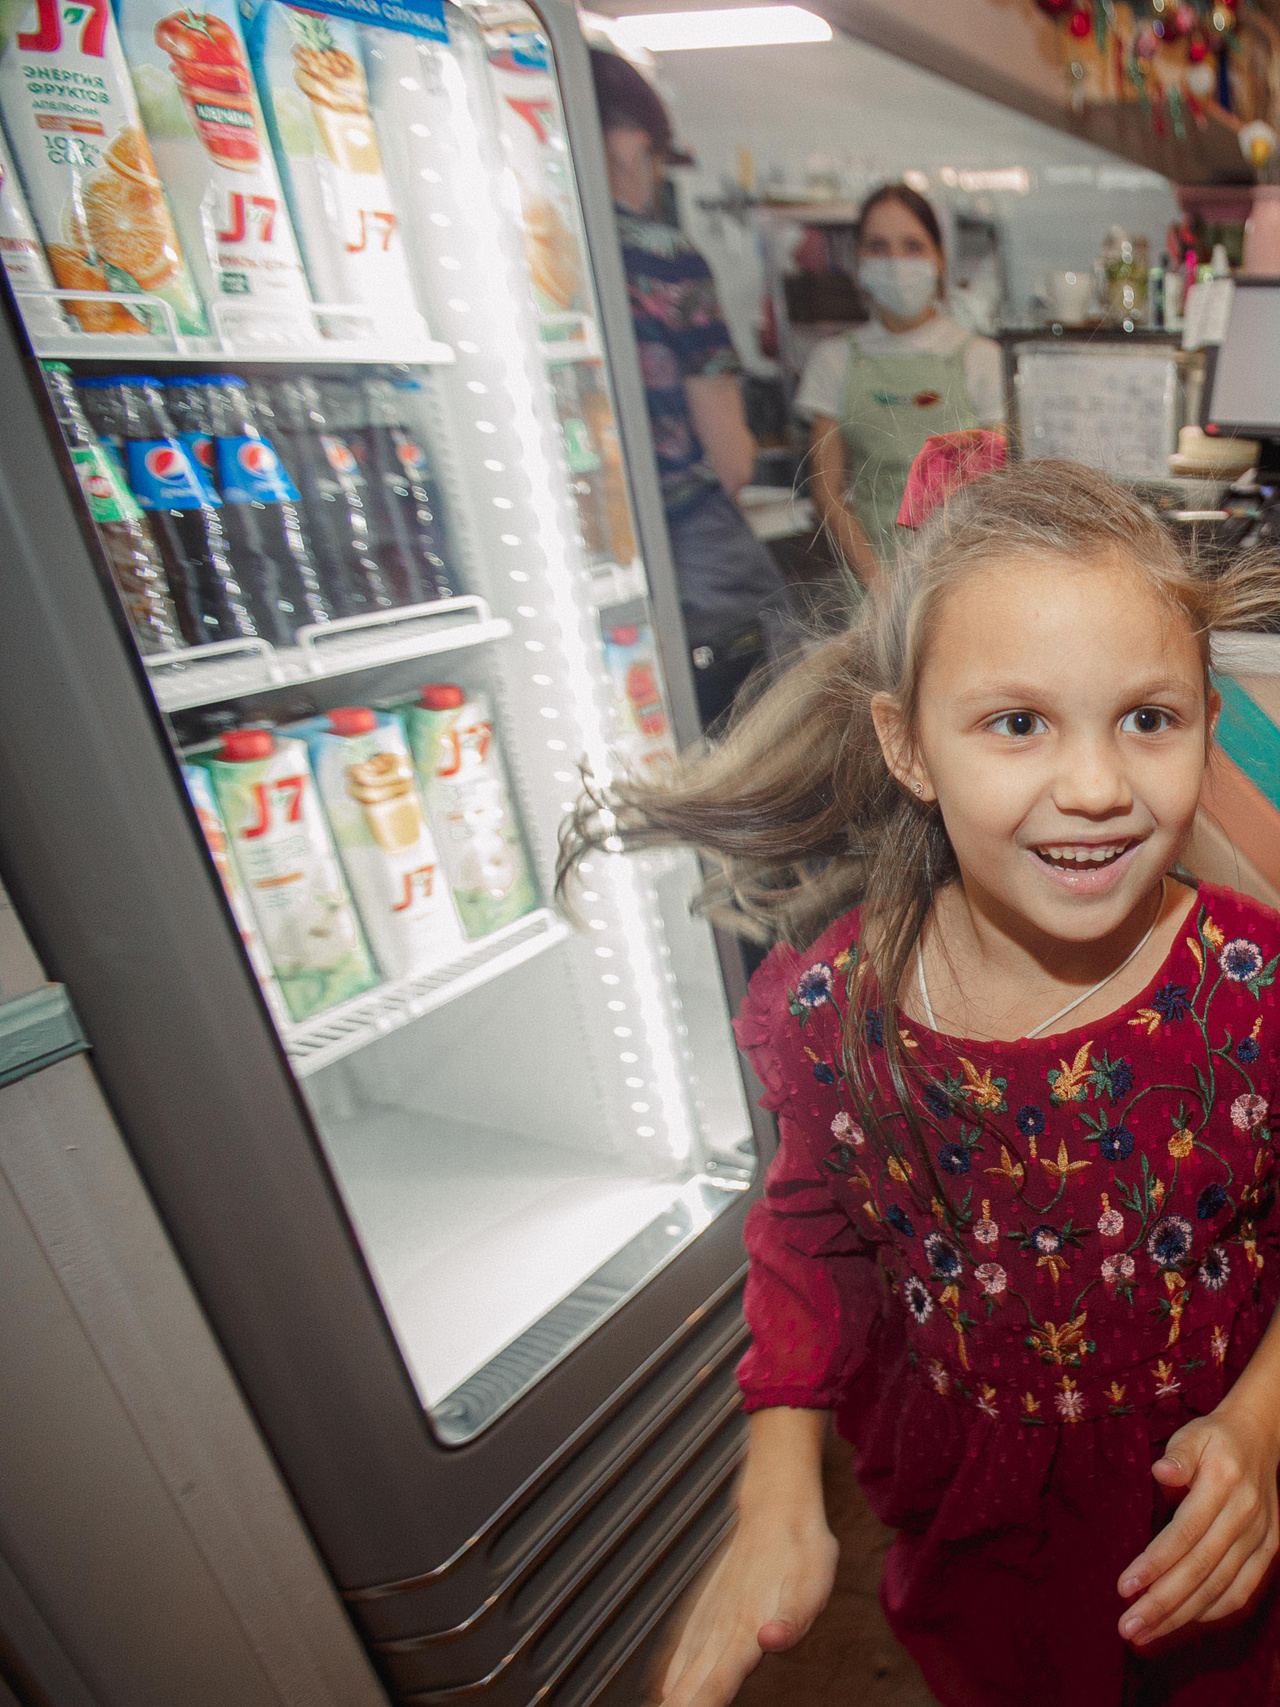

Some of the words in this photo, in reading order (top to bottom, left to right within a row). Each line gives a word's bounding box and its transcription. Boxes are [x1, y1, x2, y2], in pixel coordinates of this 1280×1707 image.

[16, 0, 108, 58] J7
[22, 65, 105, 88] ЭНЕРГИЯ
[27, 82, 110, 104] ФРУКТОВ
[48, 150, 98, 168] СОК
[217, 191, 276, 242] J7
[345, 210, 397, 252] J7
[437, 722, 492, 777] J7
[241, 775, 305, 839] J7
[391, 864, 436, 912] J7
